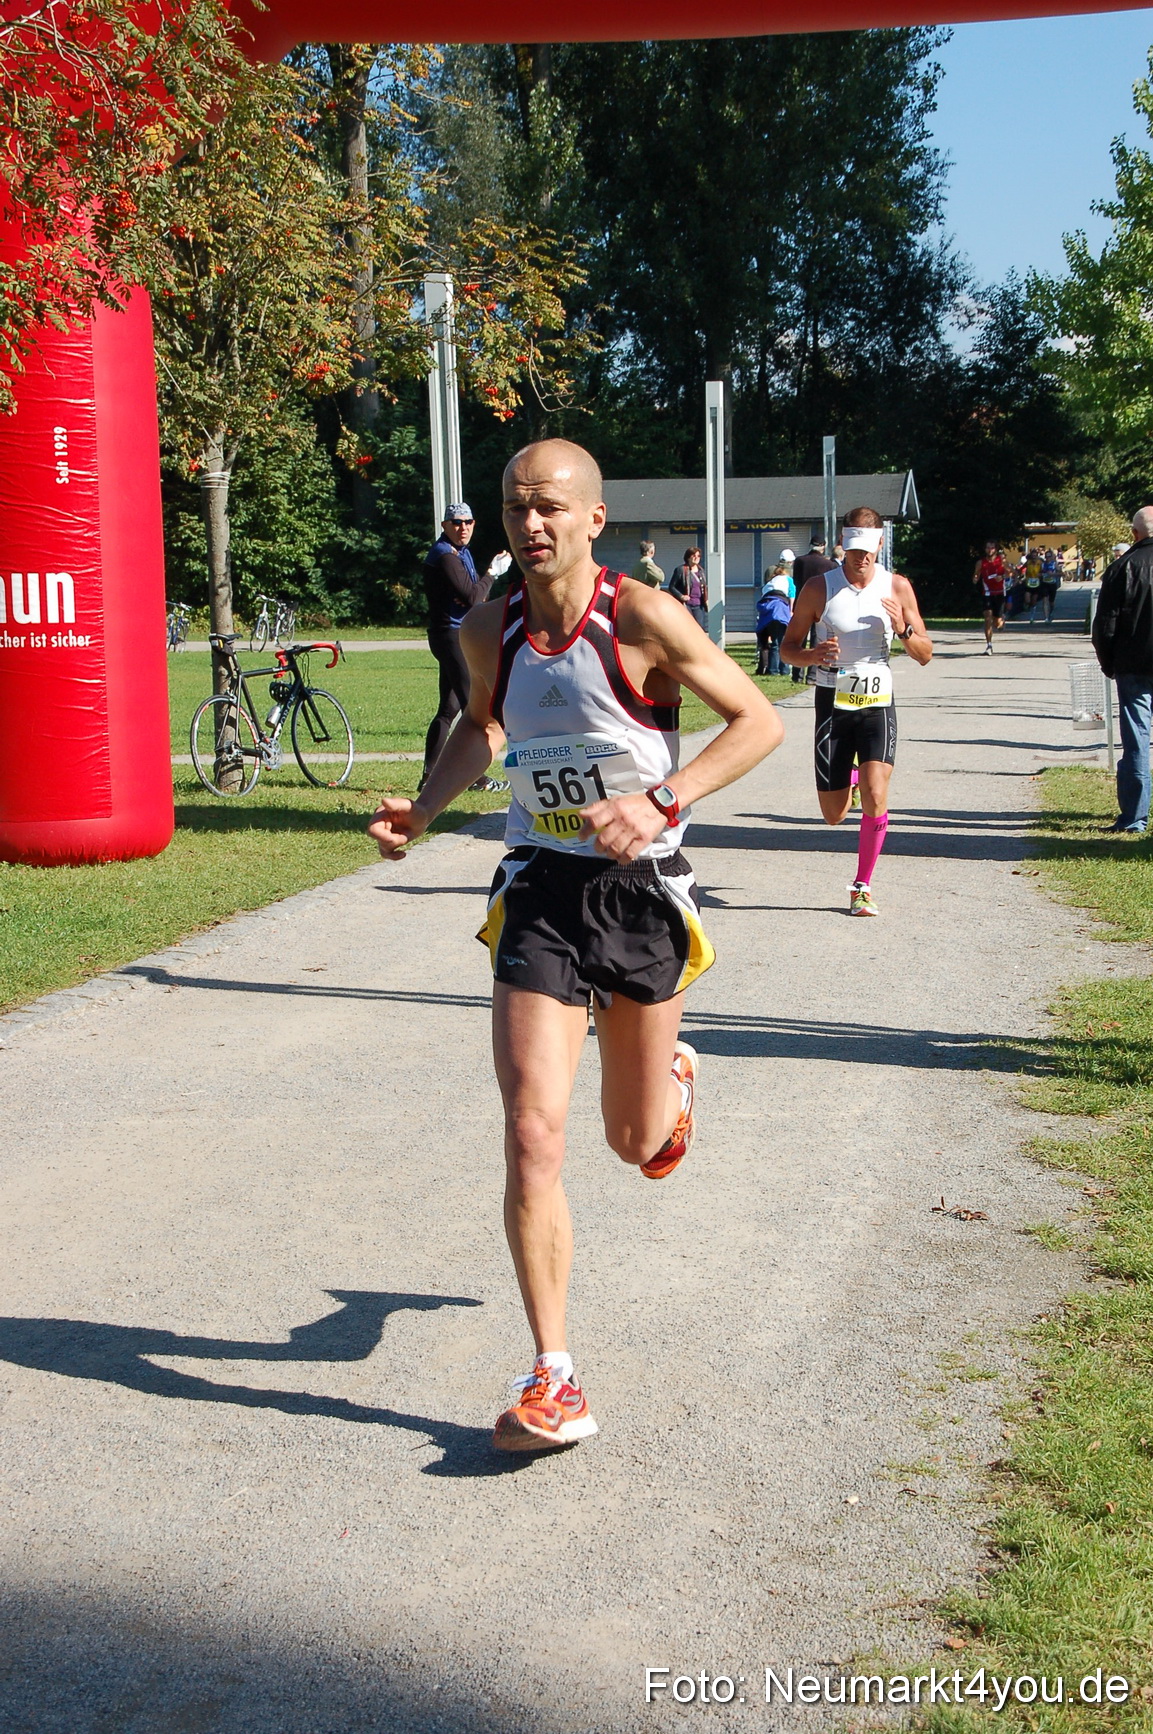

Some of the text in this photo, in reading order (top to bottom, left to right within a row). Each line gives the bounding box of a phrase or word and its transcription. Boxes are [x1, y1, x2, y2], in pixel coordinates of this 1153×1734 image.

[53, 426, 69, 484] Seit 1929
[30, 632, 47, 648] ist
[51, 629, 91, 648] sicher
[849, 675, 881, 694] 718
[539, 698, 568, 707] adidas
[848, 694, 879, 706] Stefan
[518, 743, 618, 760] PFLEIDERER BOCK
[520, 756, 574, 767] AKTIENGESELLSCHAFT
[532, 763, 607, 808] 561
[537, 811, 585, 834] Tho
